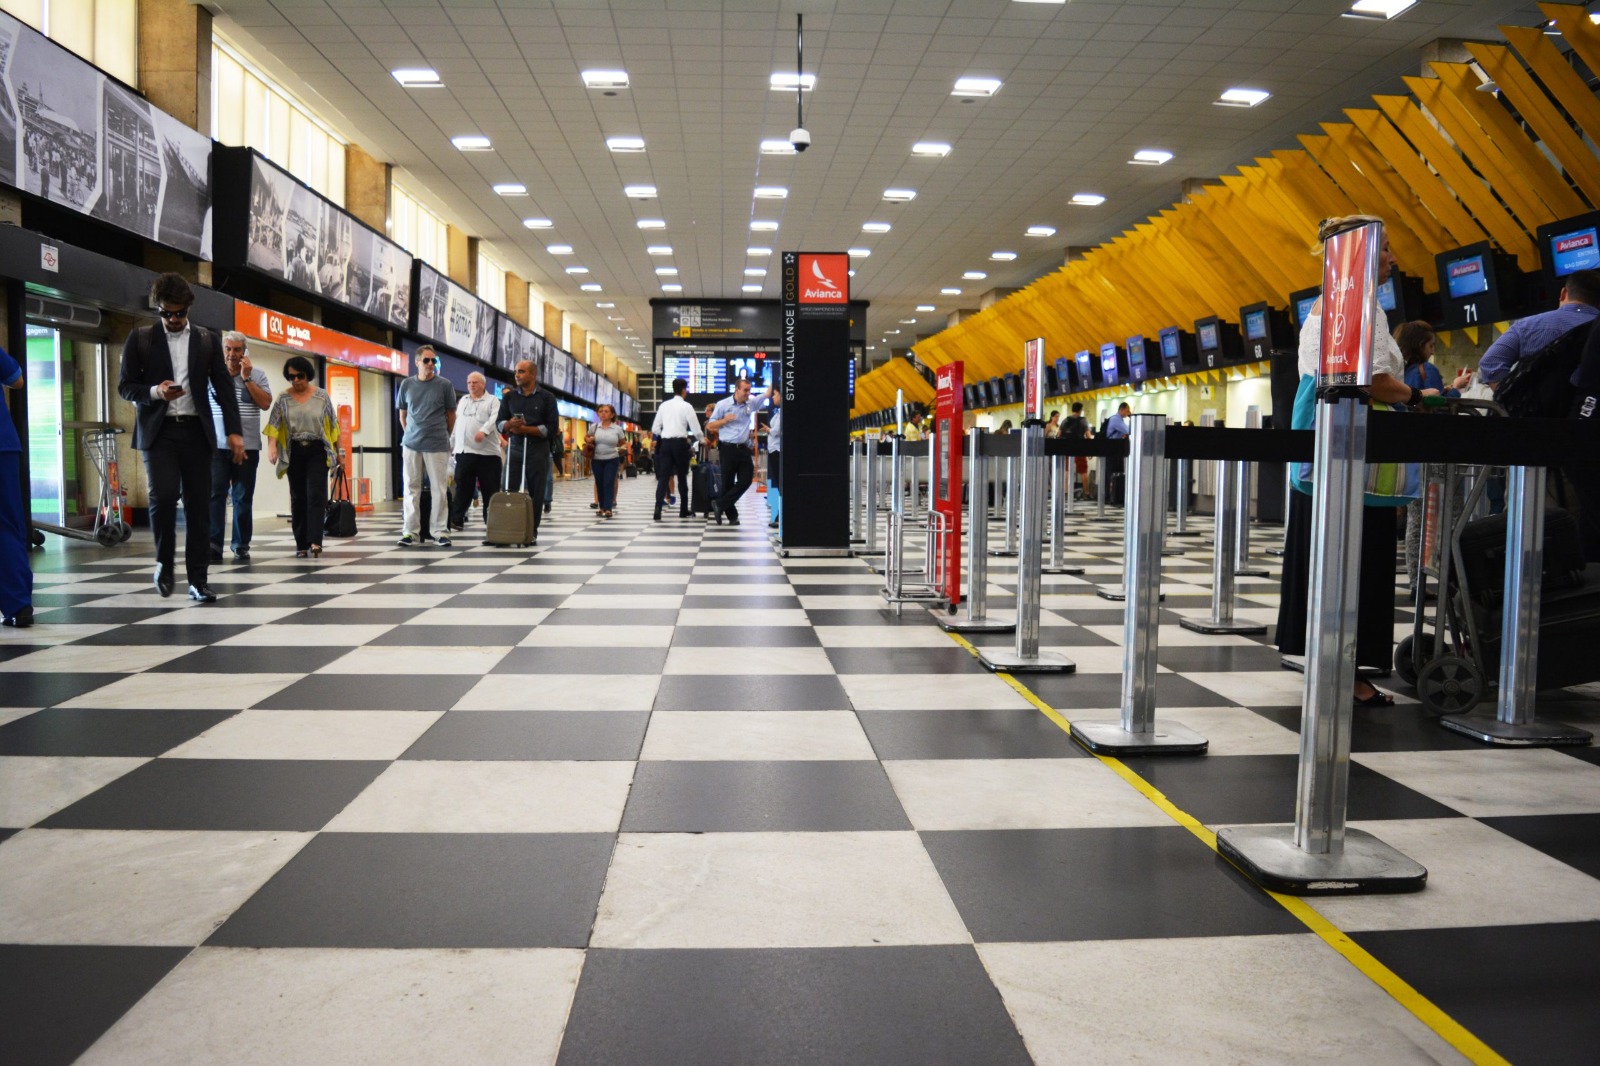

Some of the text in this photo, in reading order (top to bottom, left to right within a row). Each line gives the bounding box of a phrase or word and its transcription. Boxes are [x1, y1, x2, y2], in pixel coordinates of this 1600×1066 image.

[1559, 237, 1590, 250] Avianca
[1576, 248, 1599, 258] ENTREG
[1453, 265, 1477, 275] Avianca
[804, 288, 842, 298] Avianca
[1463, 303, 1478, 323] 71
[270, 316, 284, 335] GOL
[785, 267, 795, 401] STAR ALLIANCE GOLD
[1207, 354, 1214, 367] 67
